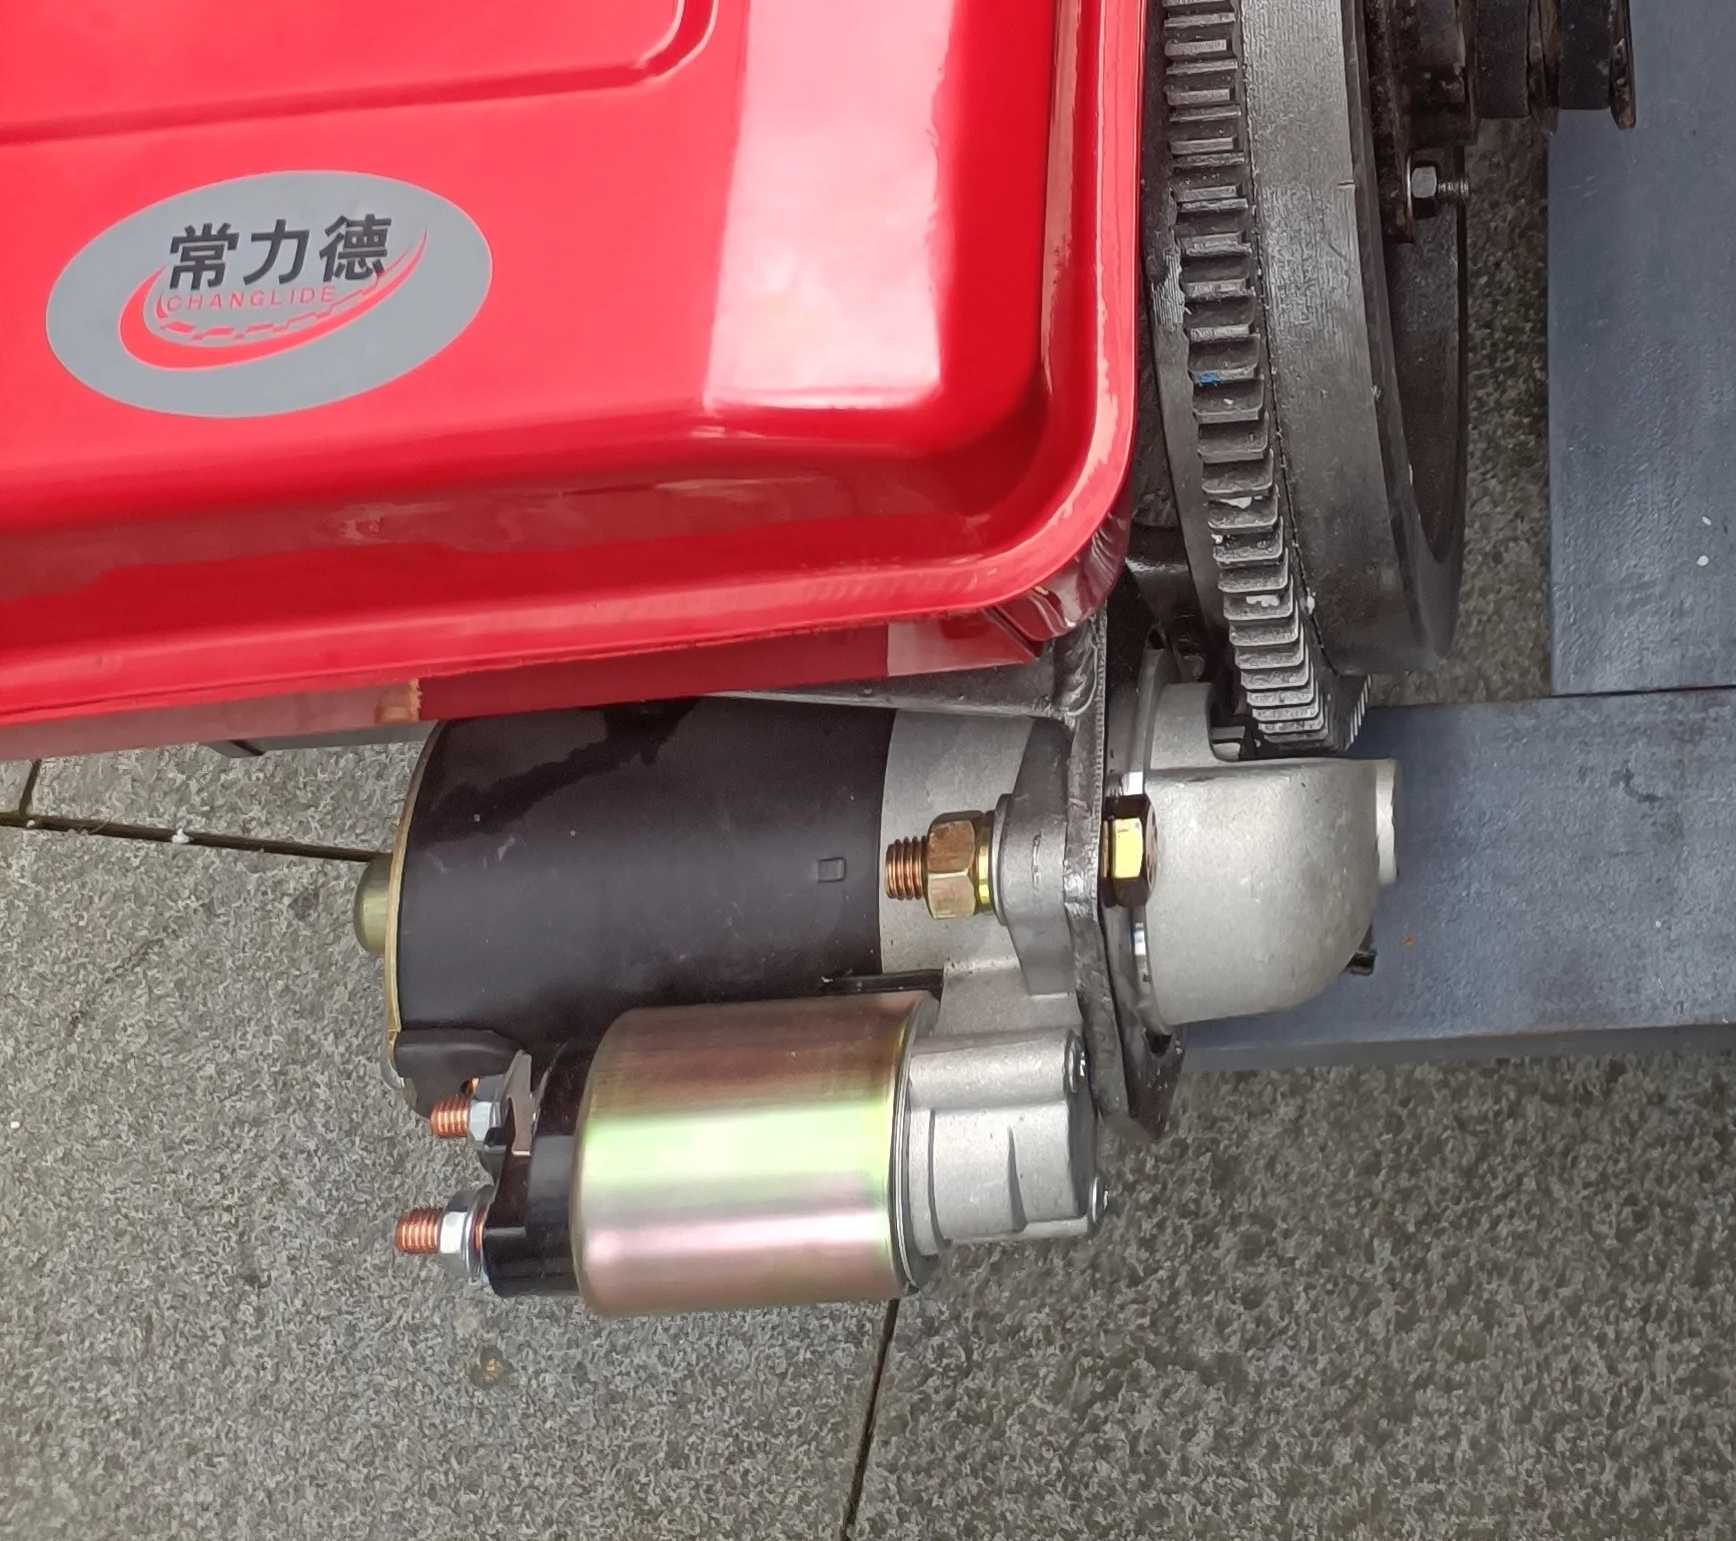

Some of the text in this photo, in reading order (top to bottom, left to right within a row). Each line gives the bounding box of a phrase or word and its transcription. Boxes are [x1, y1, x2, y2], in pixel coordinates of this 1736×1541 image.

[169, 214, 392, 291] 常力德
[165, 285, 338, 313] CHANGLIDE
